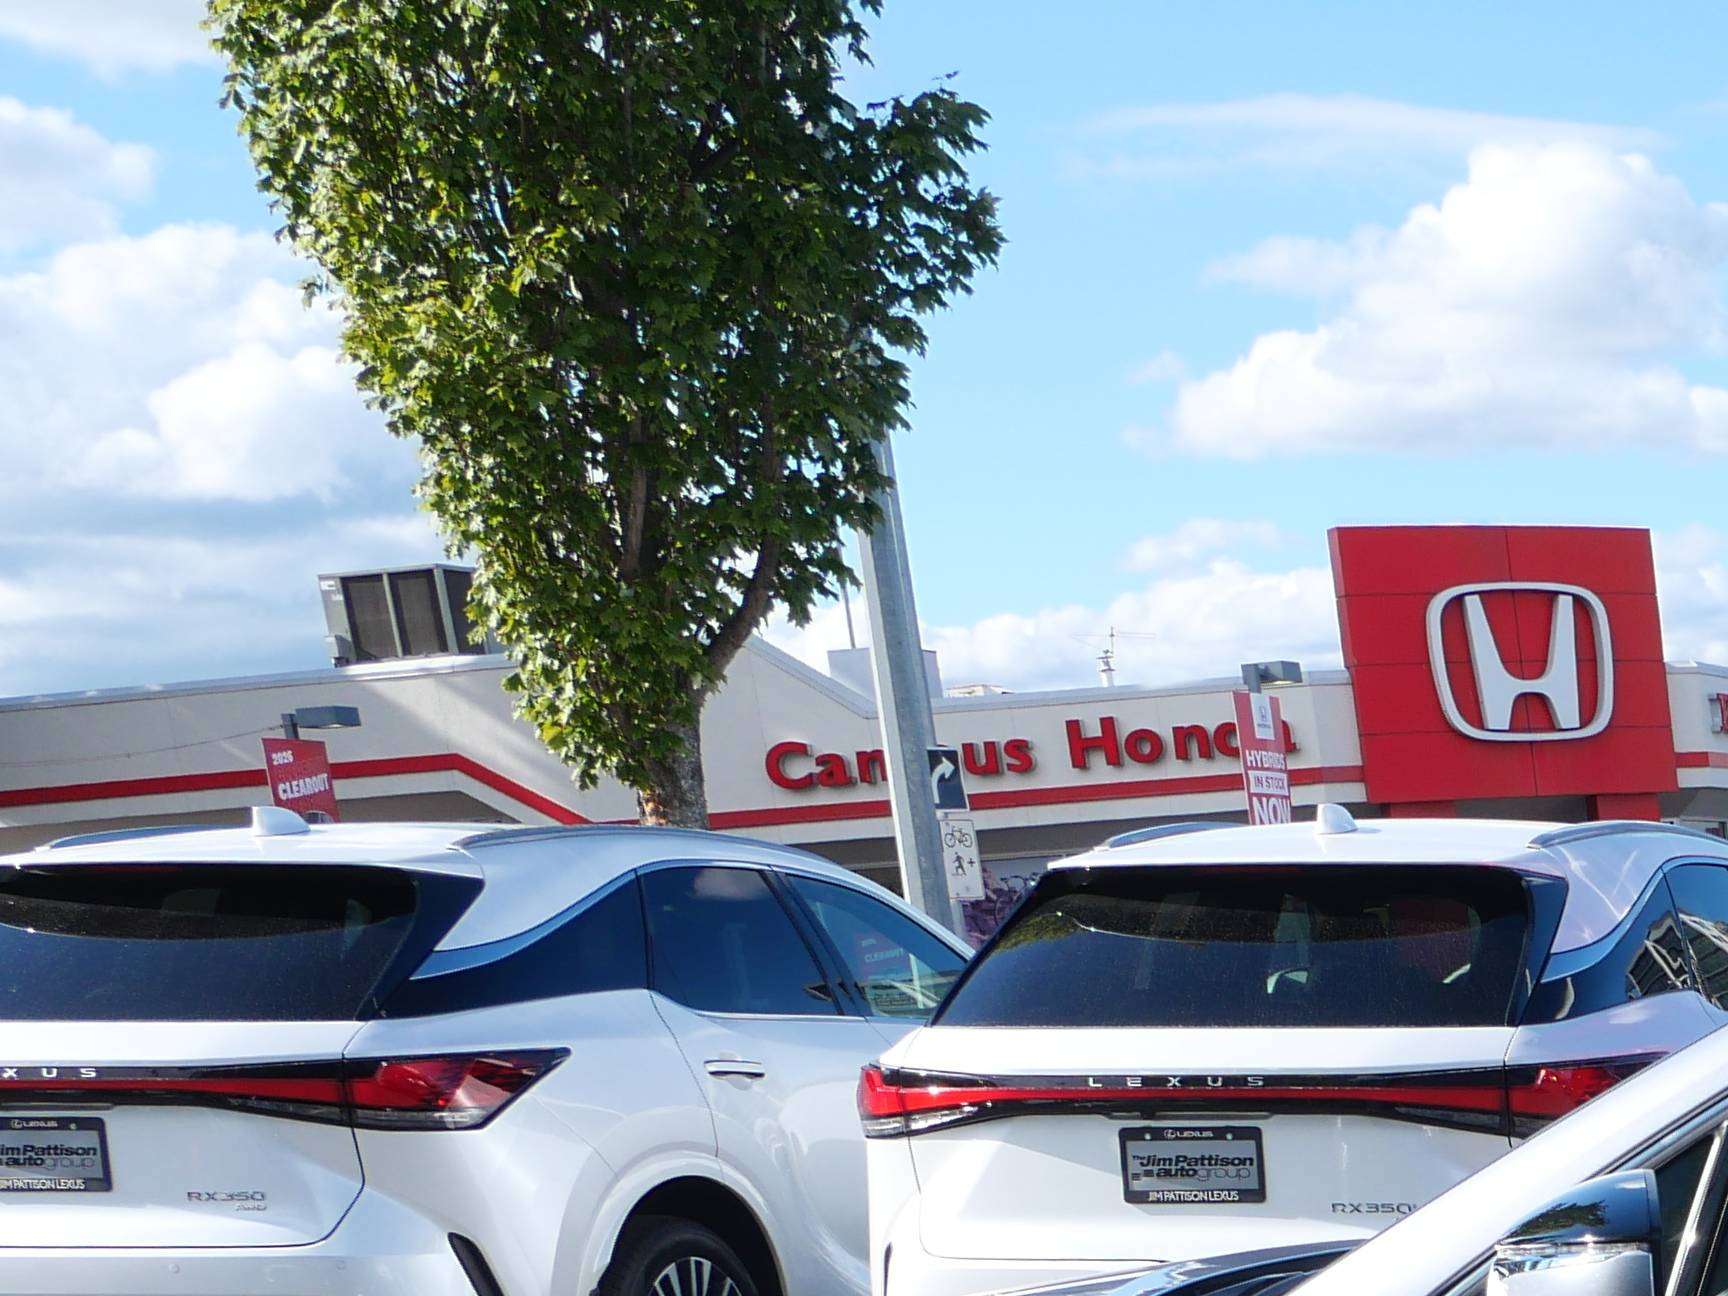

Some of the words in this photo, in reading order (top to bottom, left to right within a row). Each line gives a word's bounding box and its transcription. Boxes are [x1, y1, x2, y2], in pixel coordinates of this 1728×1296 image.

[278, 773, 329, 800] CLEAROUT
[1255, 776, 1264, 788] IN
[1265, 776, 1285, 790] STOCK
[1253, 797, 1291, 825] NOW
[1088, 1076, 1264, 1088] LEXUS
[1177, 1130, 1213, 1138] LEXUS
[22, 1144, 97, 1157] Pattison
[1140, 1155, 1174, 1167] Jim
[1175, 1155, 1254, 1168] Pattison
[14, 1179, 55, 1190] PATTISON
[56, 1179, 86, 1190] LEXUS
[1149, 1191, 1163, 1201] JIM
[1164, 1191, 1207, 1201] PATTISON
[1208, 1191, 1239, 1201] LEXUS
